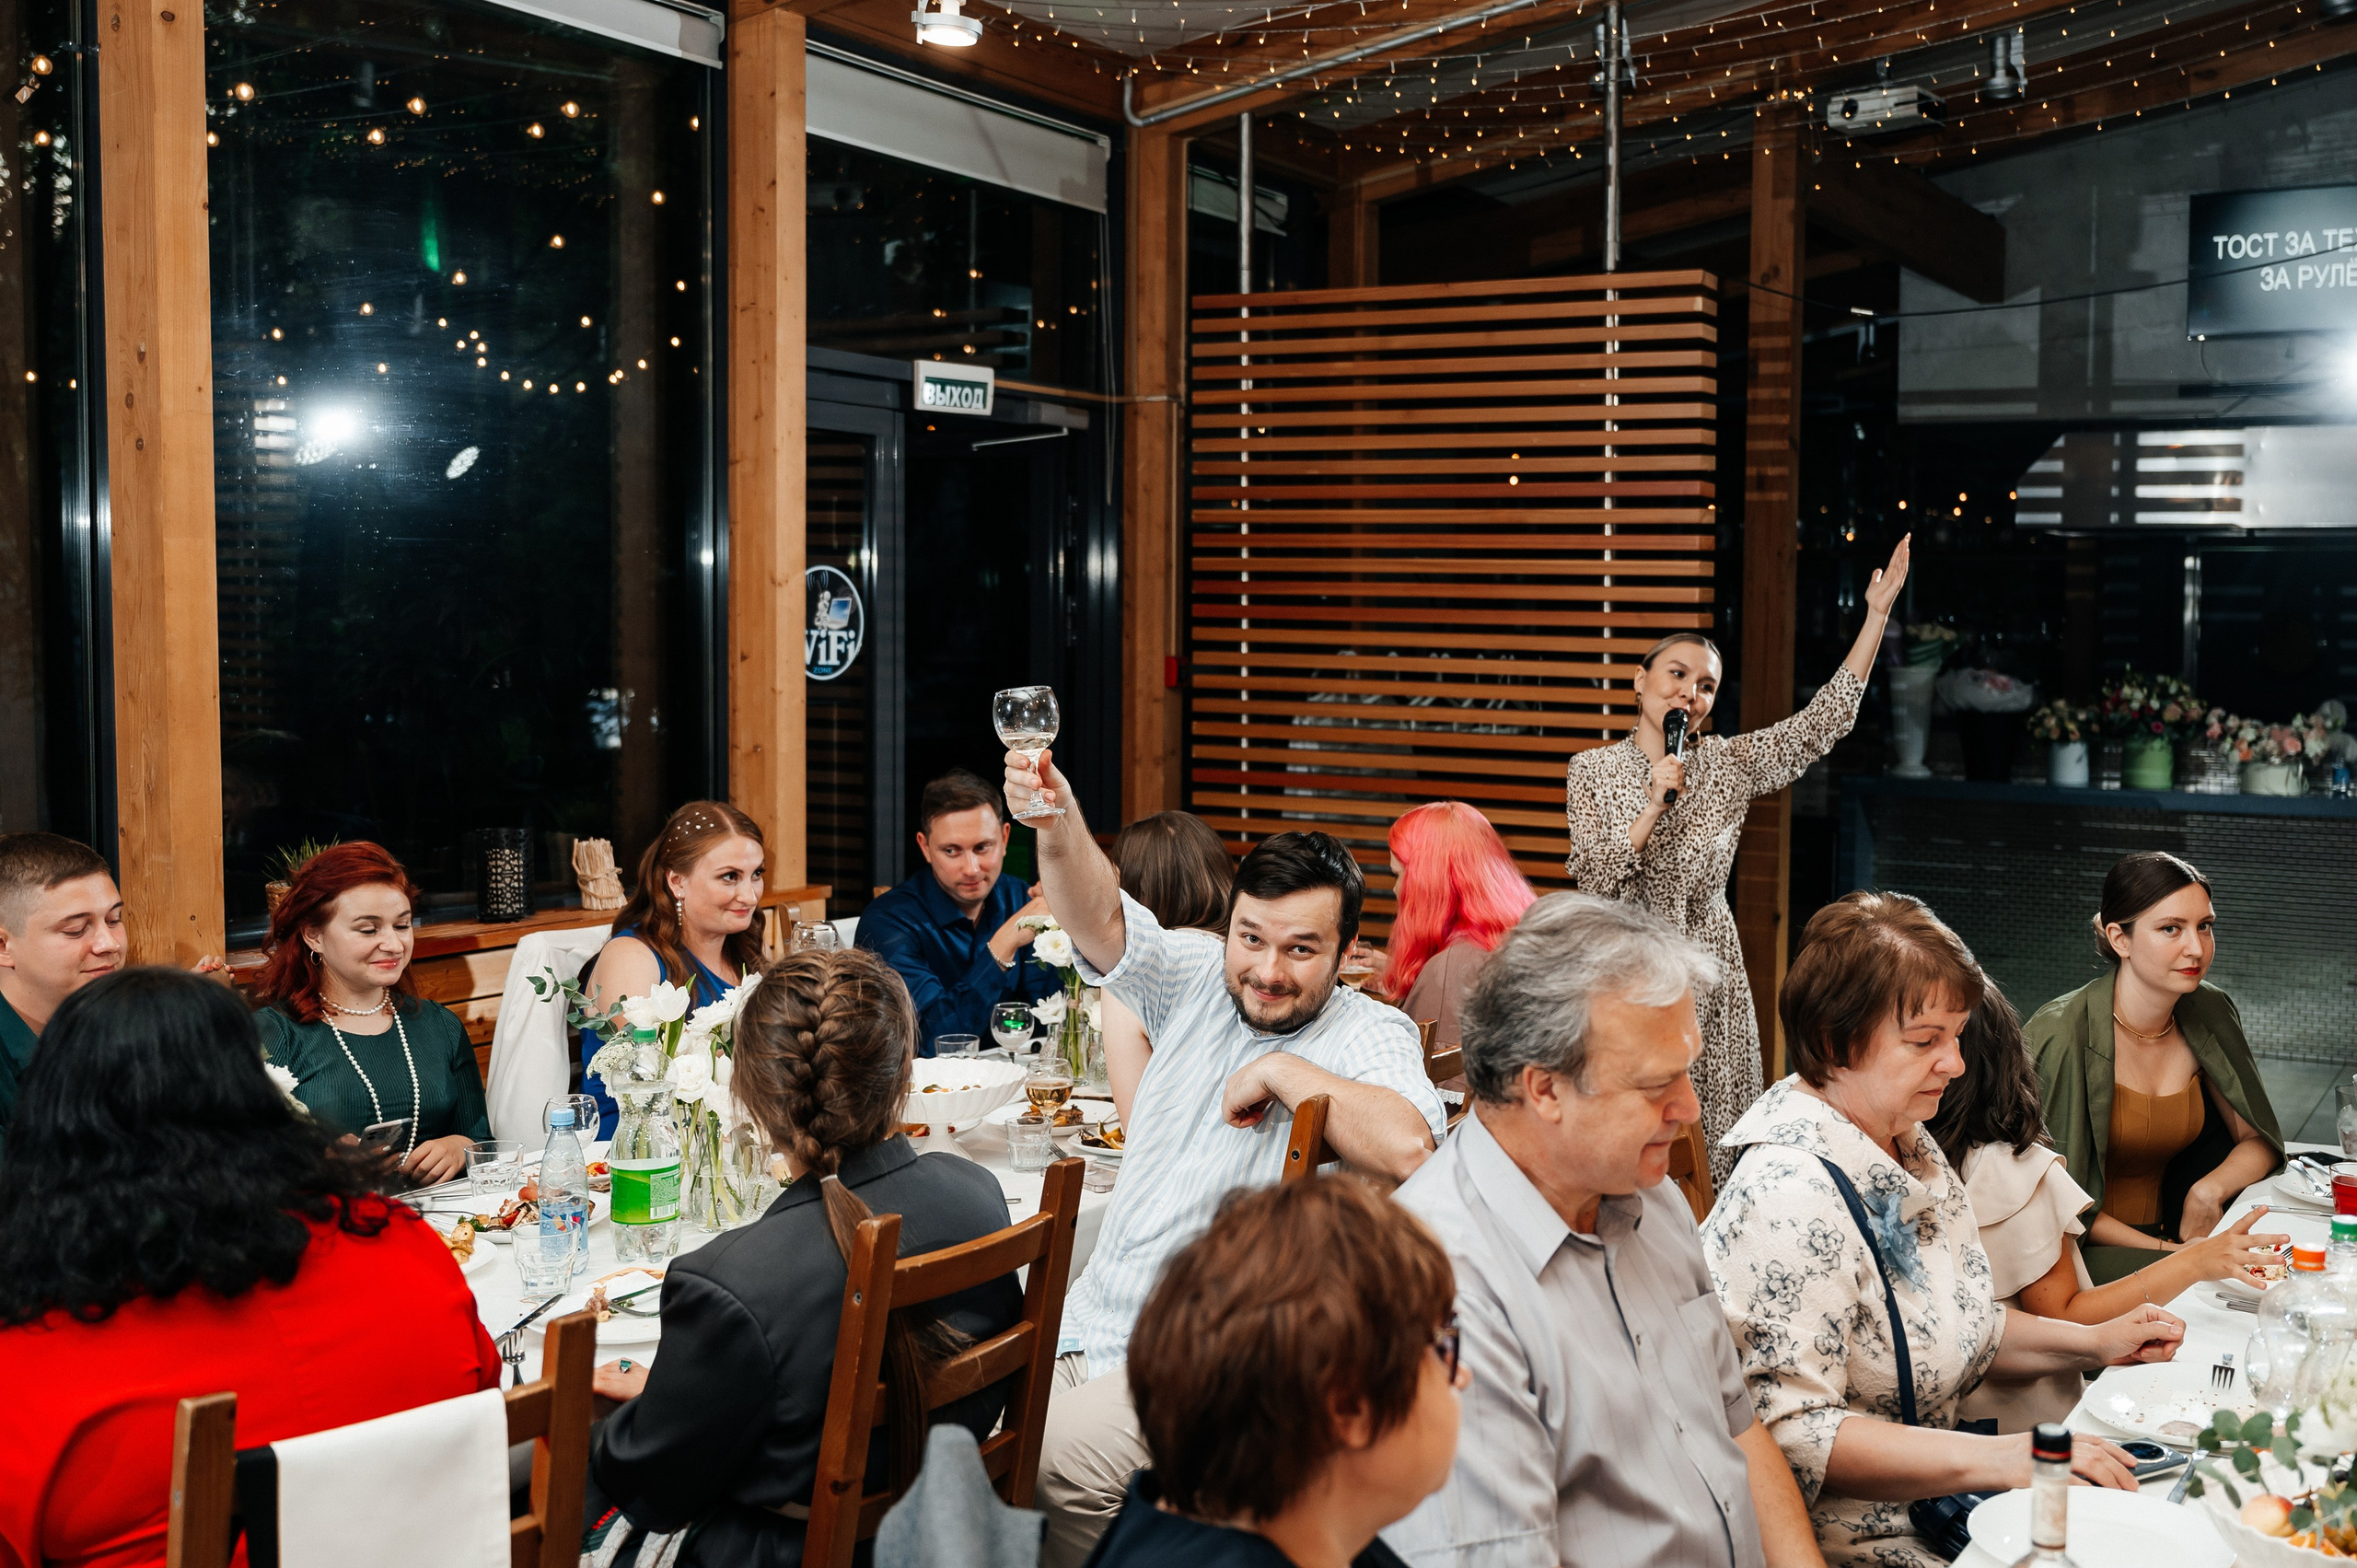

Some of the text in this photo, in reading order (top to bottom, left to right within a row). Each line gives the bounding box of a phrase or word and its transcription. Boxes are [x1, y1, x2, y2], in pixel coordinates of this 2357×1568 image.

[2212, 226, 2357, 260] ТОСТ ЗА ТЕ
[2259, 266, 2292, 292] ЗА
[923, 381, 984, 410] ВЫХОД
